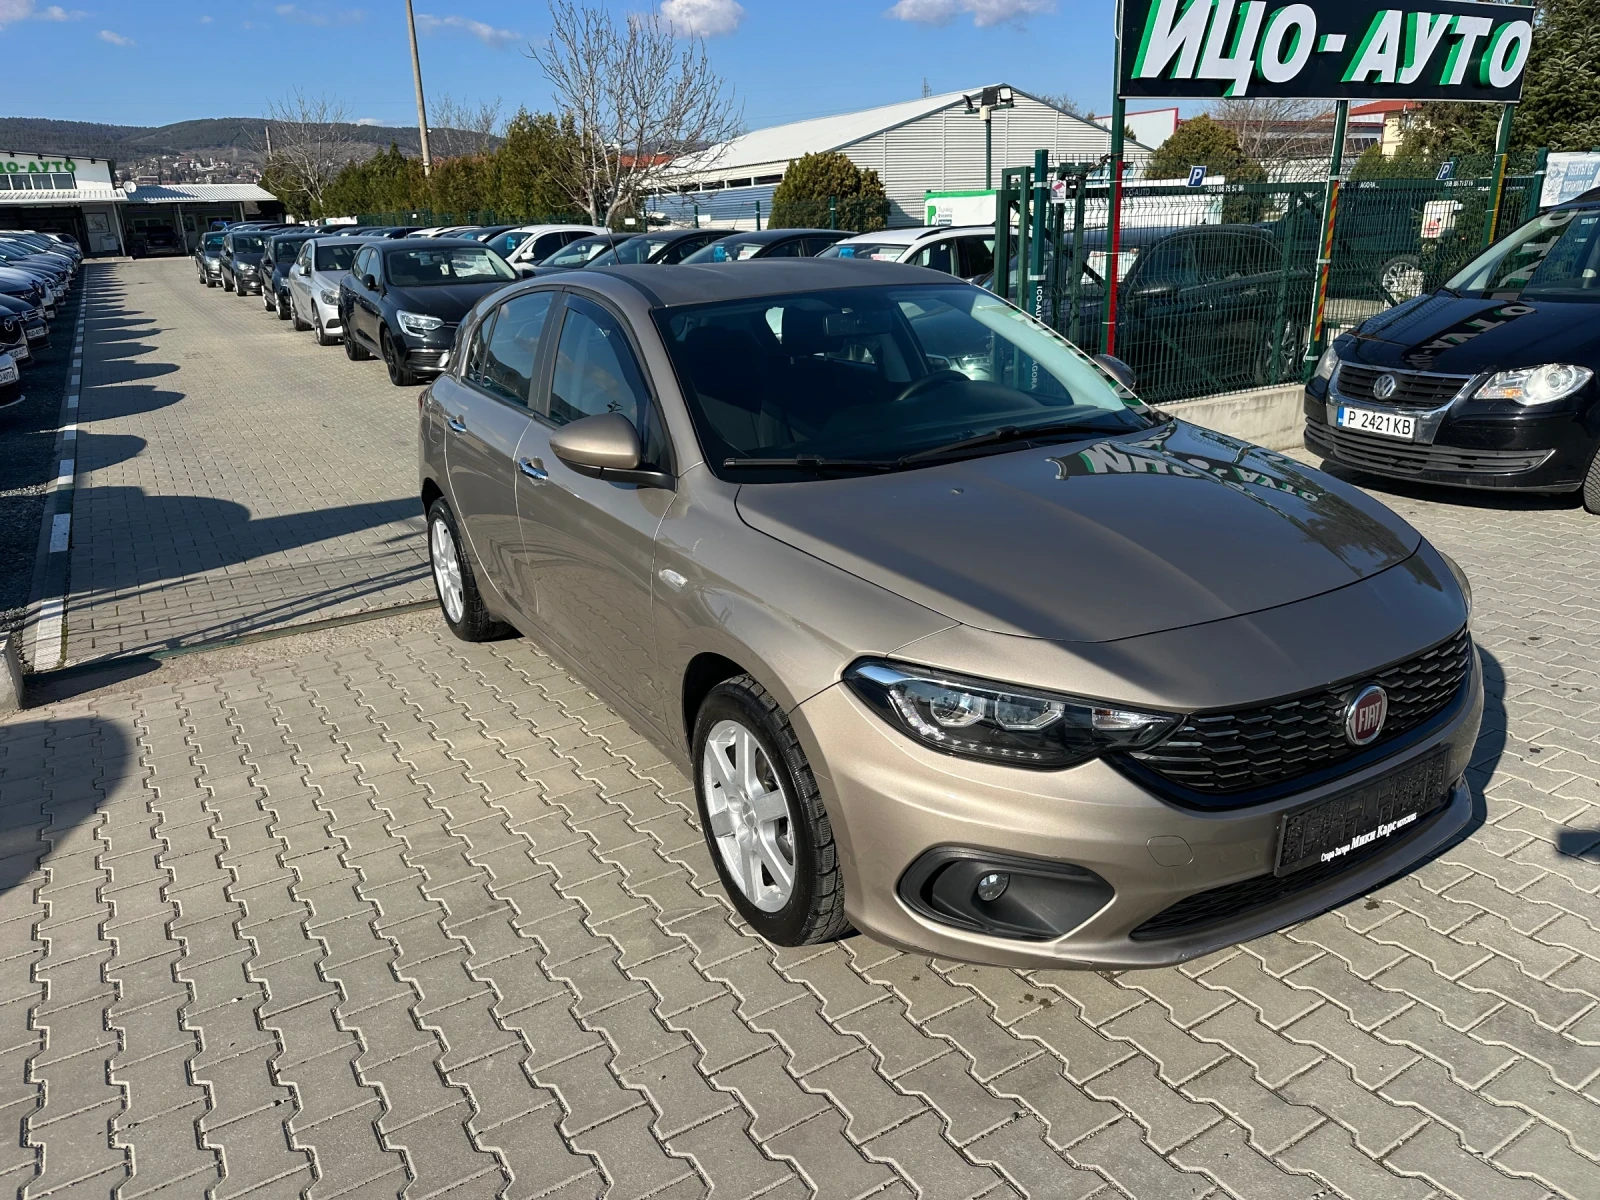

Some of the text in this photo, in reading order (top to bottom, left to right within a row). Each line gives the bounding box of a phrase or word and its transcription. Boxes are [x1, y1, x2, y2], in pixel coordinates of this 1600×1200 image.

[1348, 410, 1356, 425] P
[1361, 413, 1390, 432] 2421
[1358, 701, 1381, 733] FIAT
[1350, 830, 1377, 850] Мики
[1376, 820, 1397, 839] Карс
